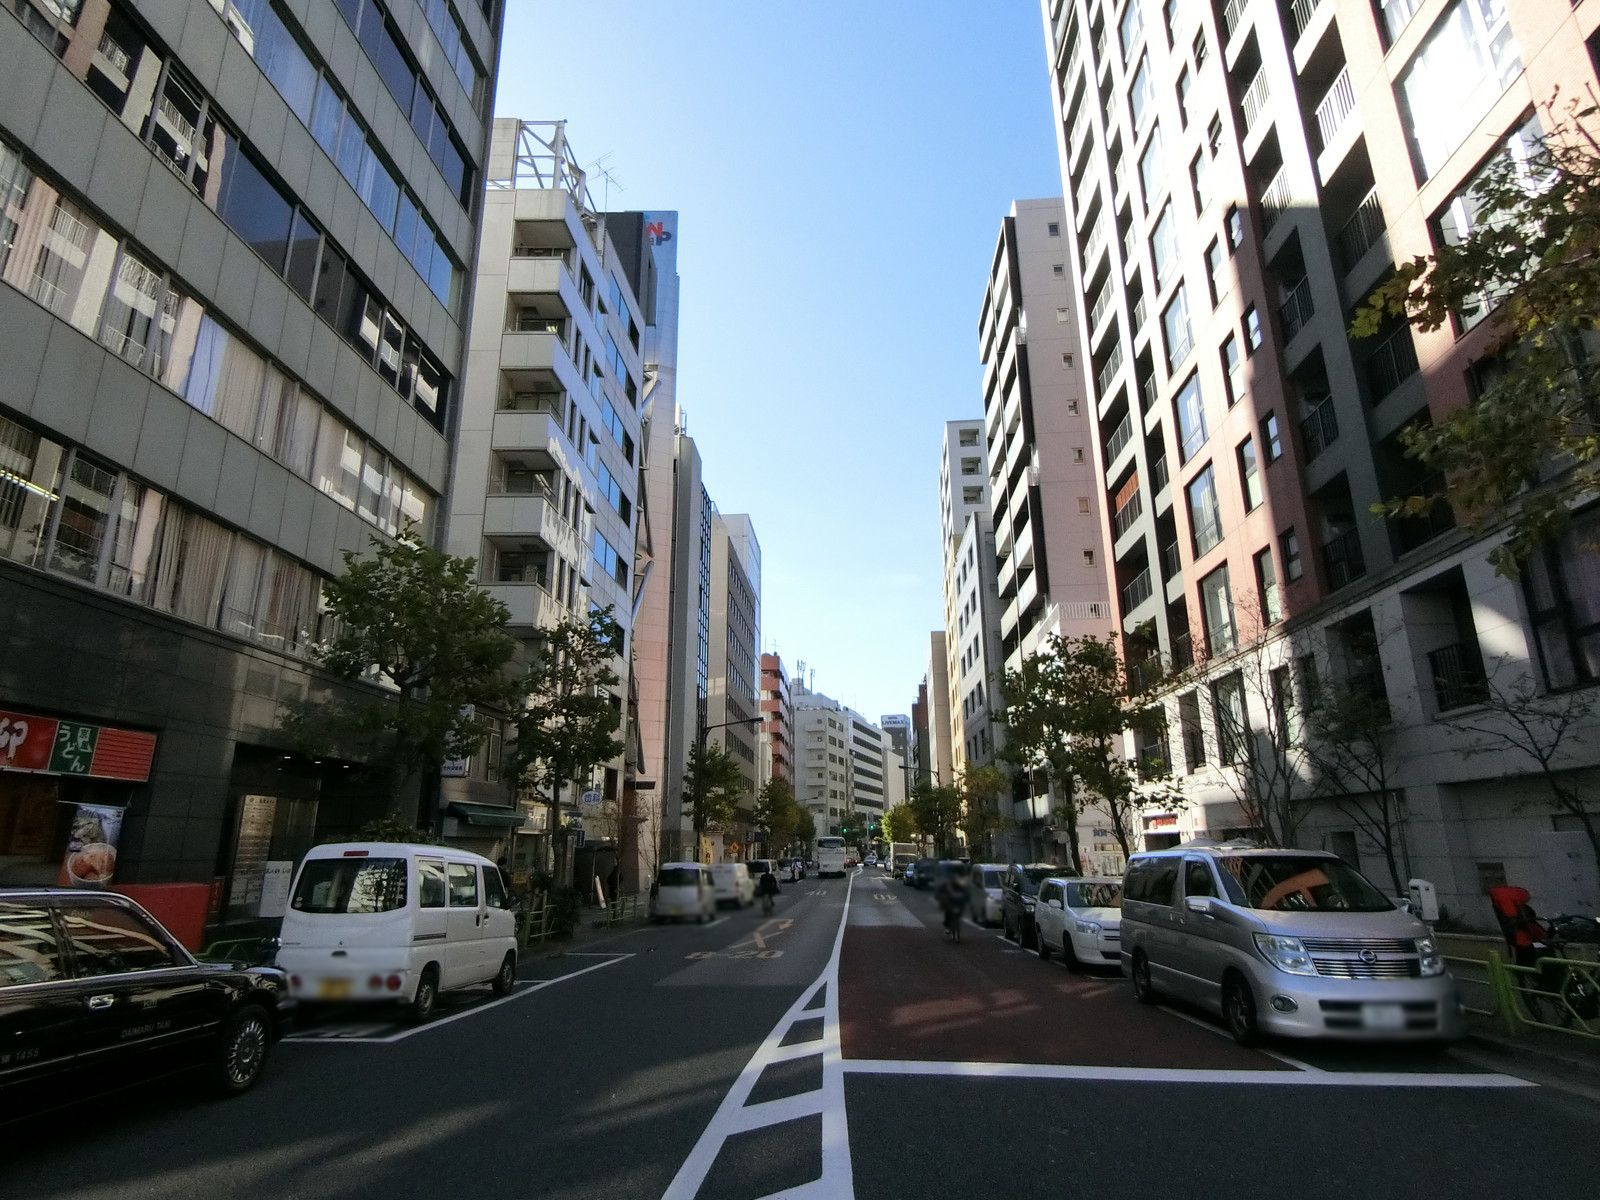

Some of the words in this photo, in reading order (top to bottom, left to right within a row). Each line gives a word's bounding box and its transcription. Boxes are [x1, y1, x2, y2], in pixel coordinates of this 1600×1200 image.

[59, 724, 86, 773] うどん
[584, 793, 601, 803] 歯科
